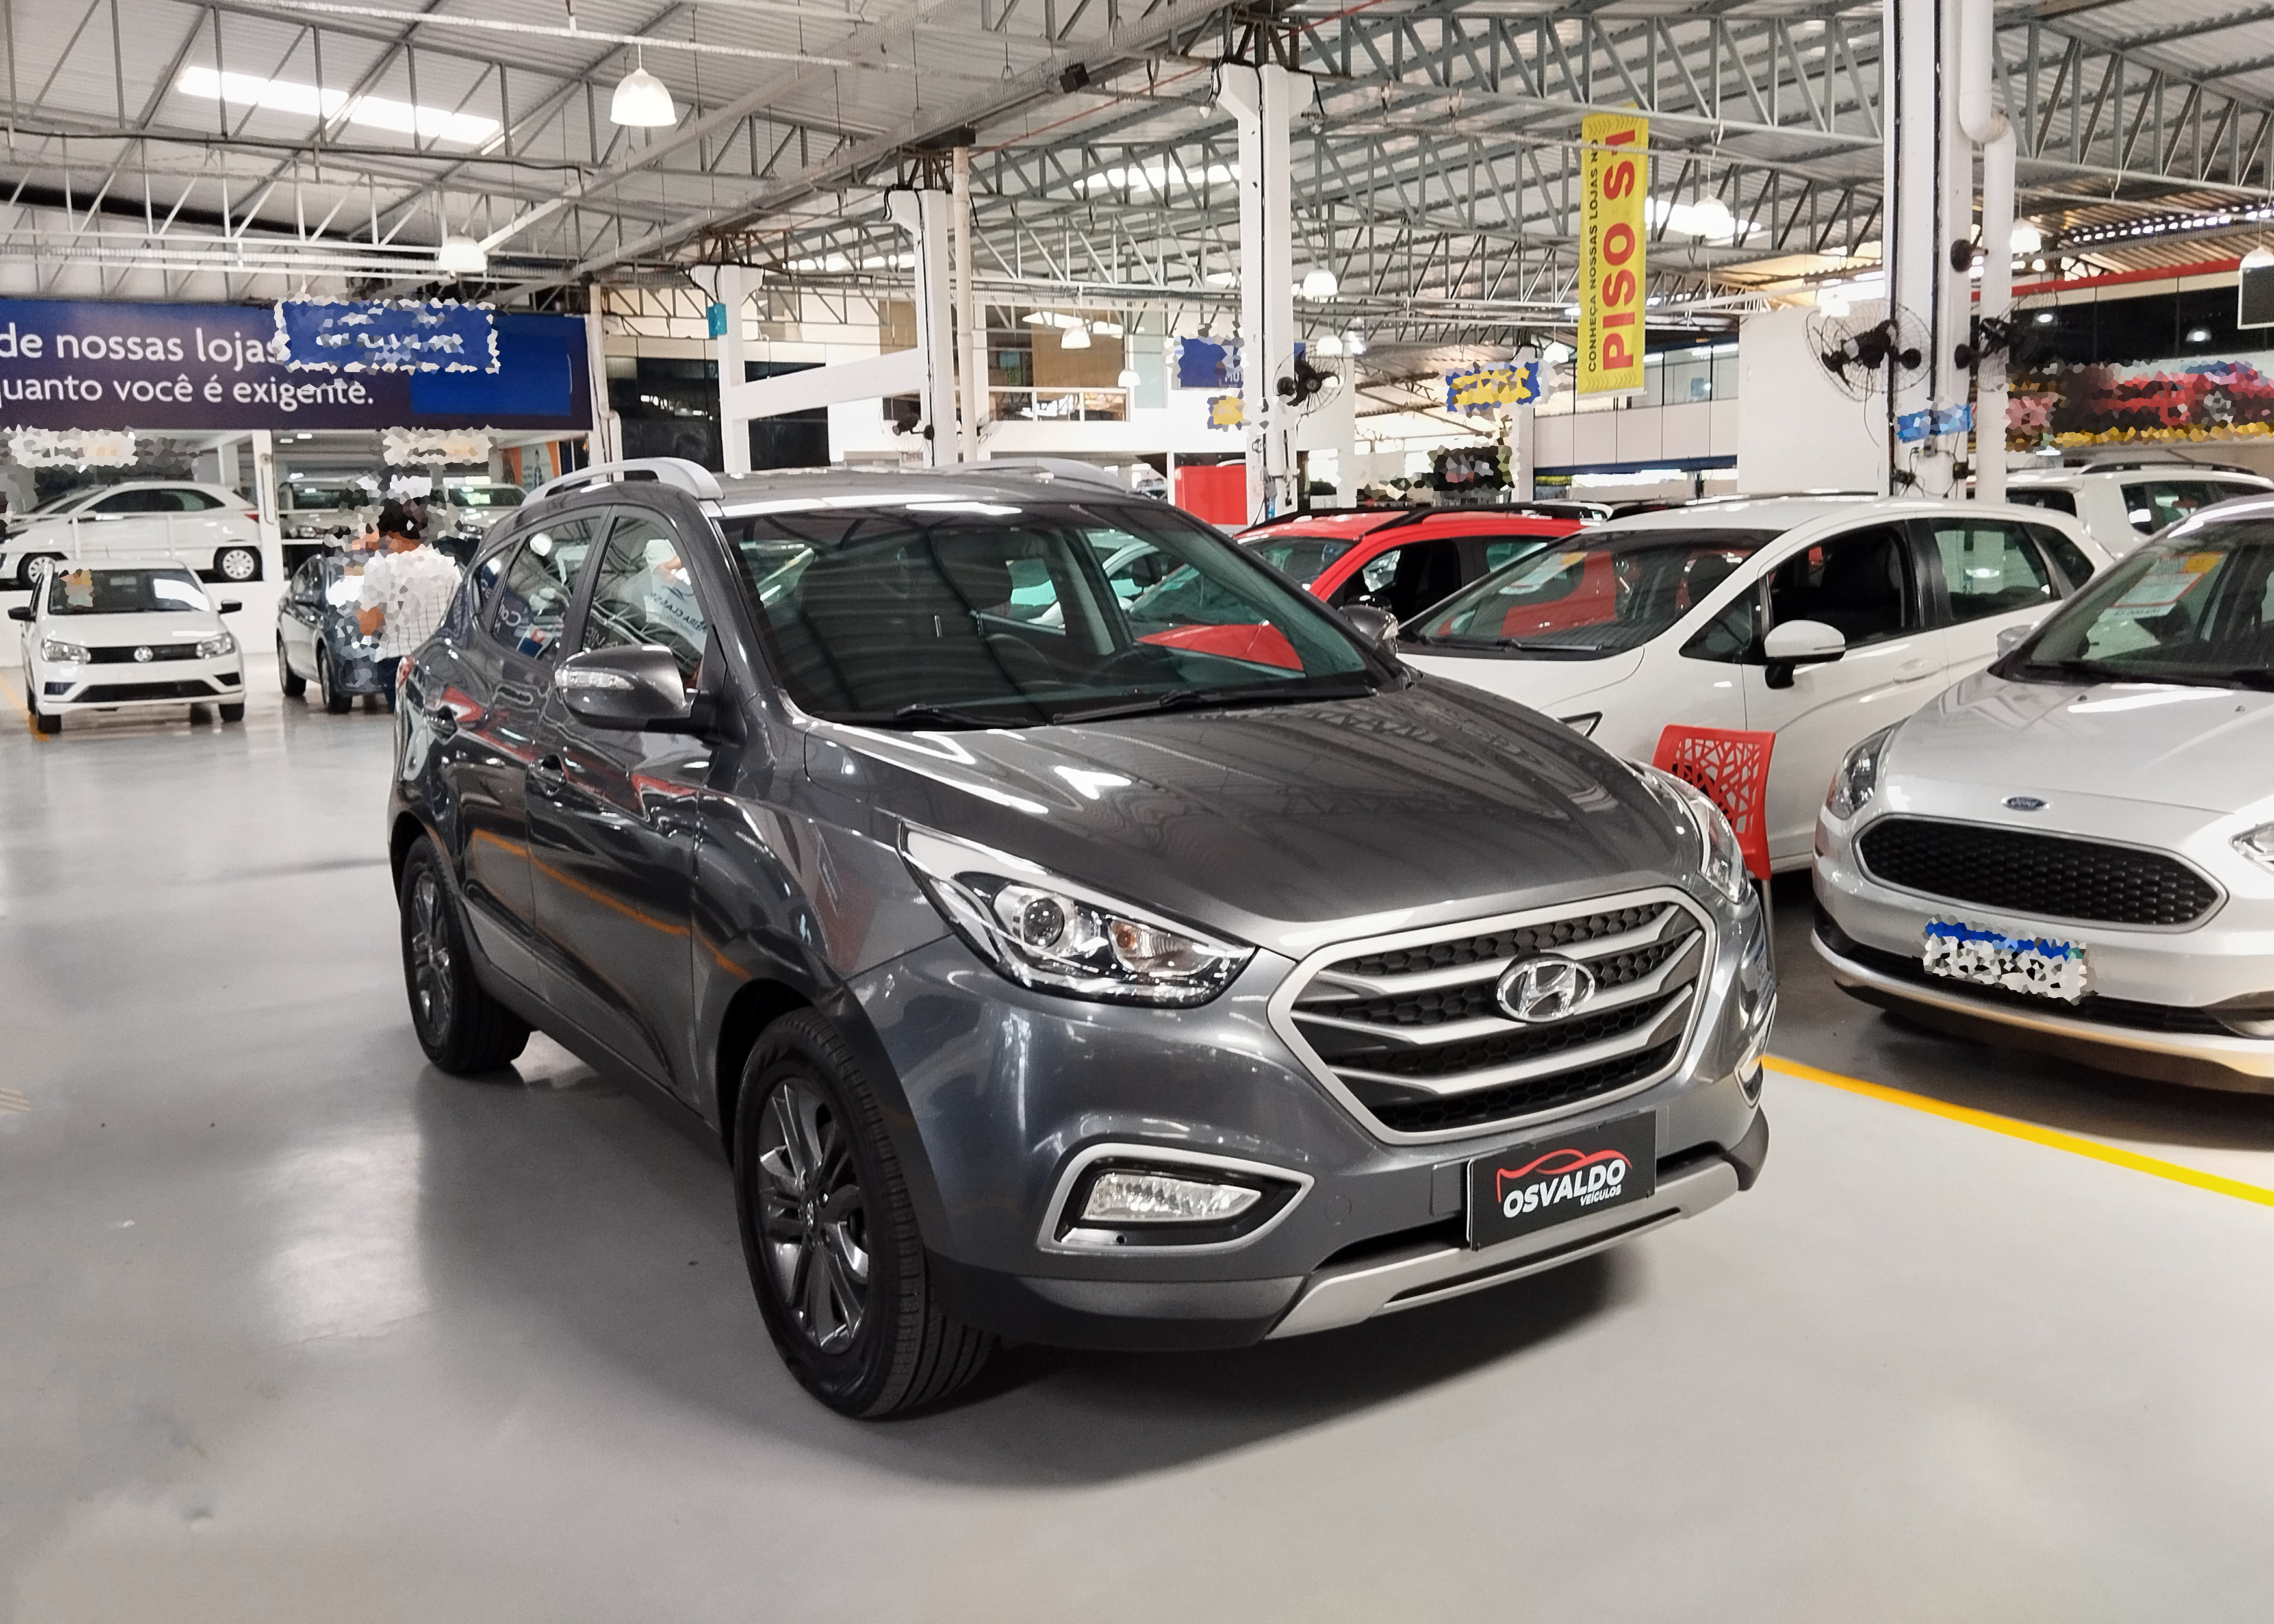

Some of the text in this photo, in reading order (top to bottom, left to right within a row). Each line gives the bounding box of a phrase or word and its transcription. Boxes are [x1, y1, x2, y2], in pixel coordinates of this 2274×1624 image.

[1589, 168, 1598, 220] LOJAS
[1602, 222, 1636, 370] PISO
[0, 322, 43, 358] de
[57, 334, 184, 361] nossas
[1589, 294, 1598, 372] CONHEÇA
[0, 374, 374, 412] uanto você é exigente.
[1503, 1159, 1626, 1218] OSVALDO
